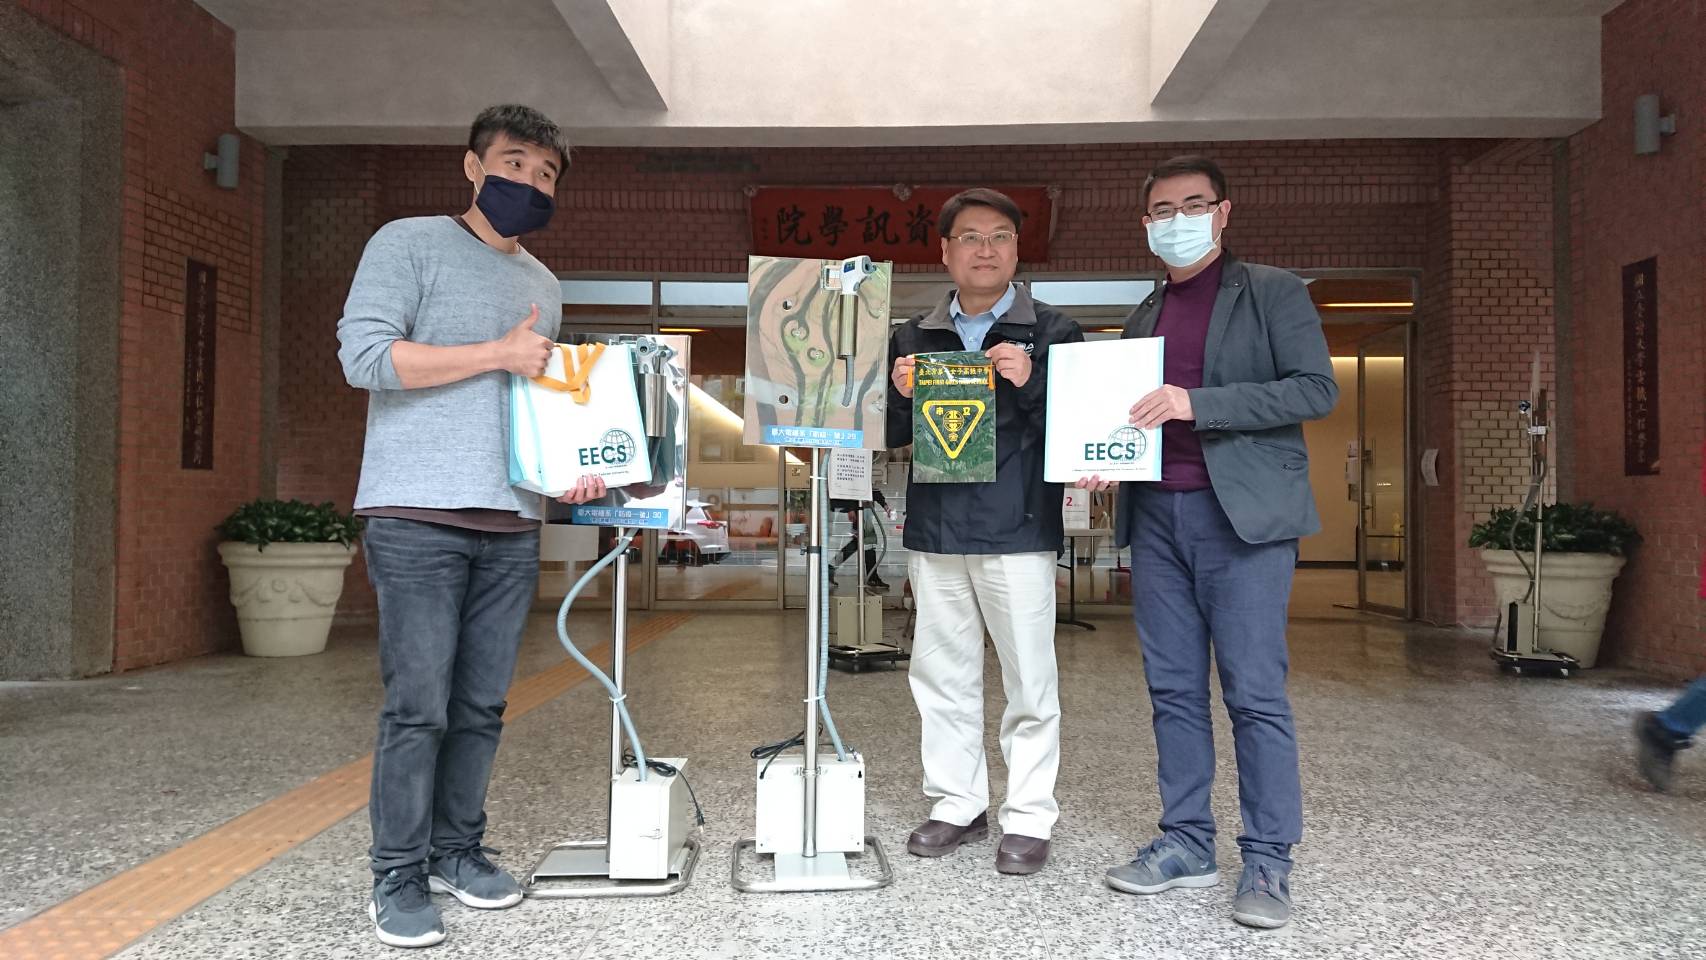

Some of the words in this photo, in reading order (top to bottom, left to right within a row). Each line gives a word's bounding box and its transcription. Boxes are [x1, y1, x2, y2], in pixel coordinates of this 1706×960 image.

[578, 445, 627, 466] EECS
[1084, 442, 1136, 461] EECS
[1066, 497, 1073, 507] 2
